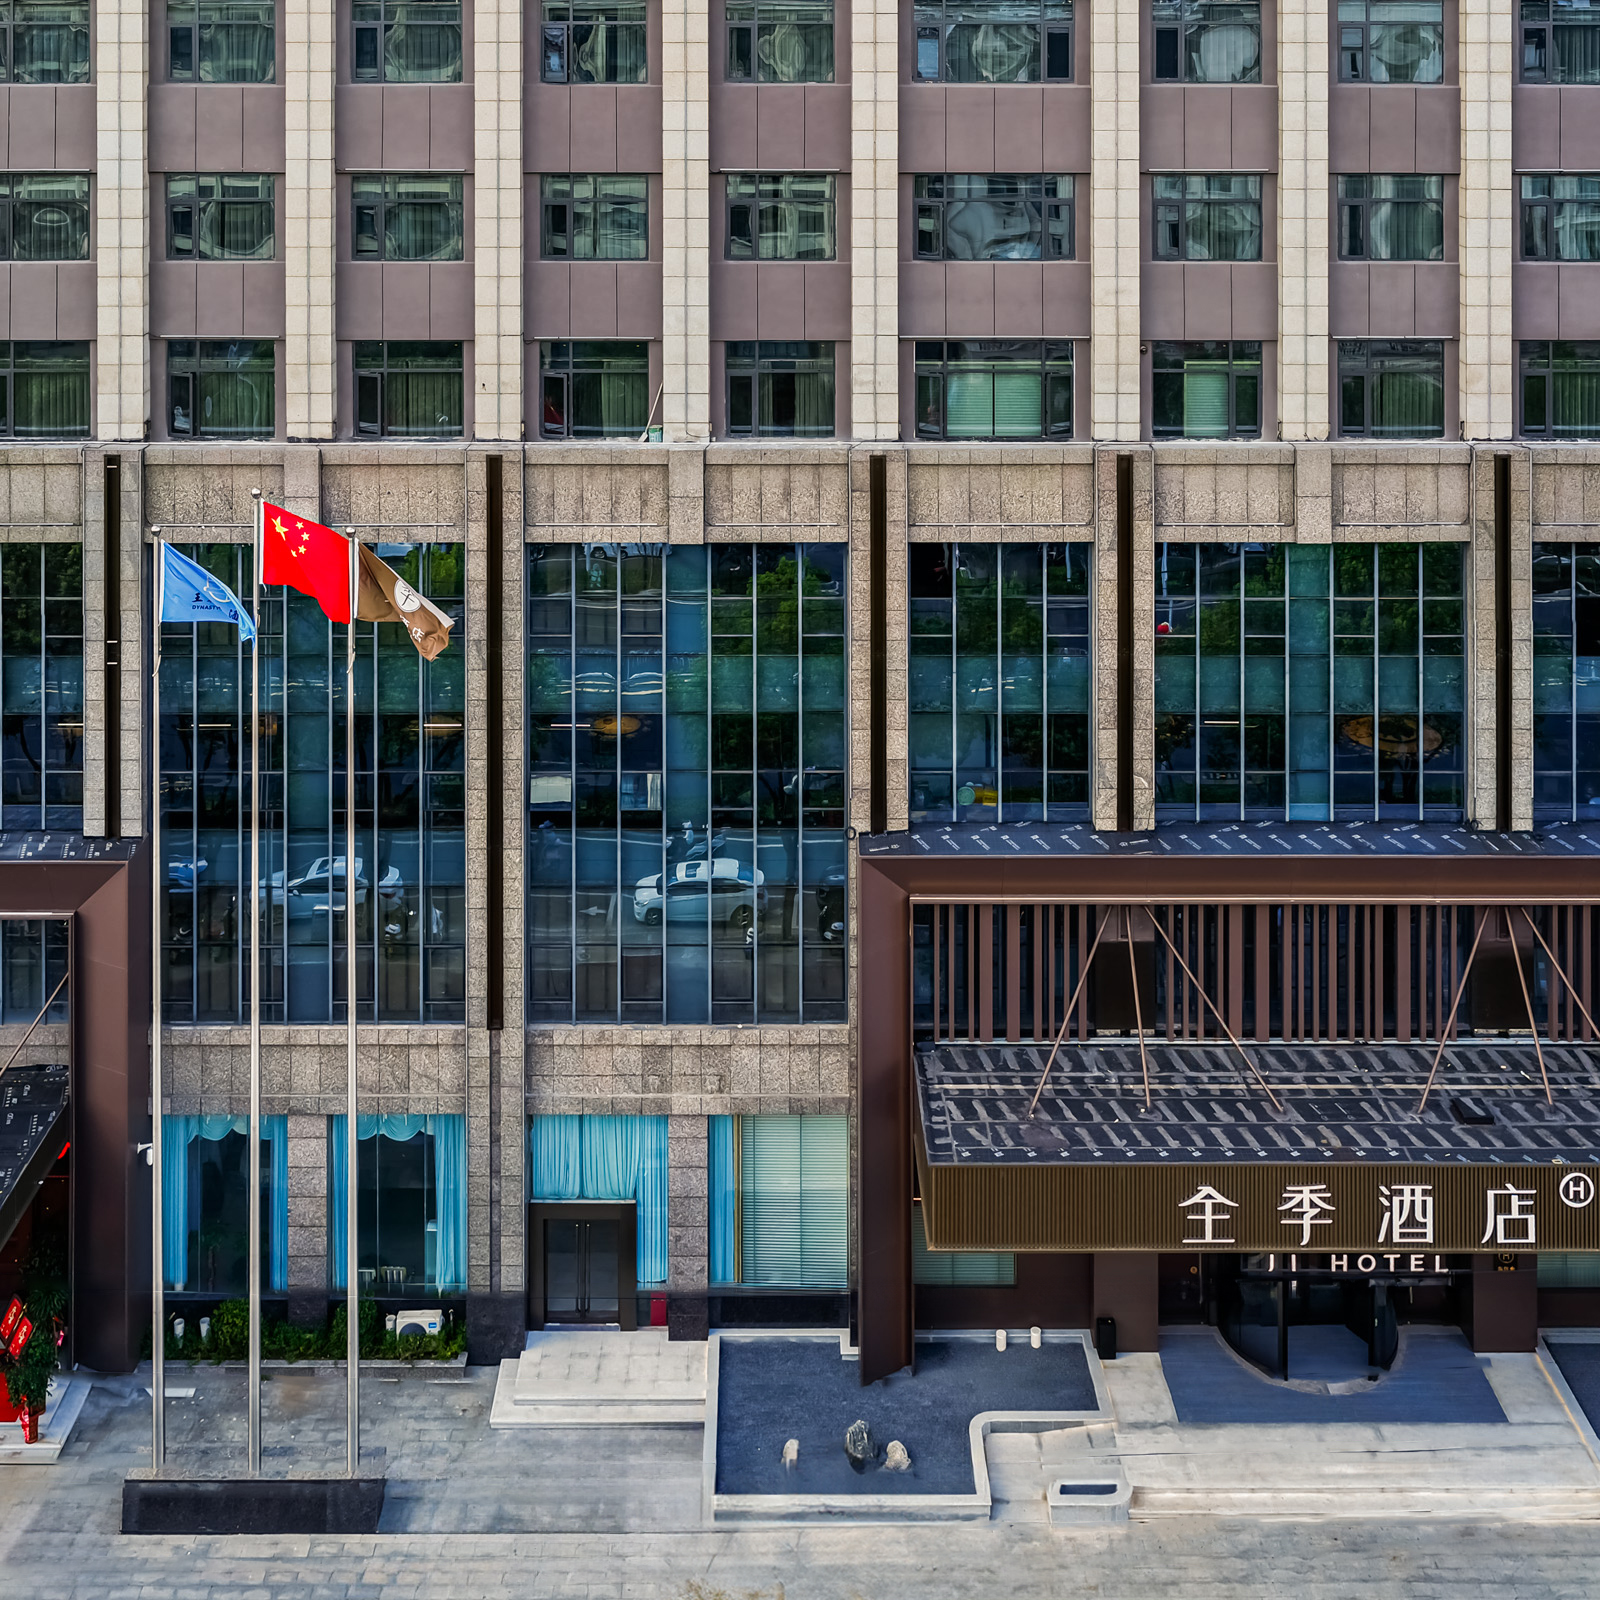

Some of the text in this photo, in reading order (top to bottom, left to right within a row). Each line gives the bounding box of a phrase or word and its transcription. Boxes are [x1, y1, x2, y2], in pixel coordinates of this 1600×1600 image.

[1178, 1183, 1537, 1246] 全季酒店
[1268, 1254, 1450, 1273] JI HOTEL
